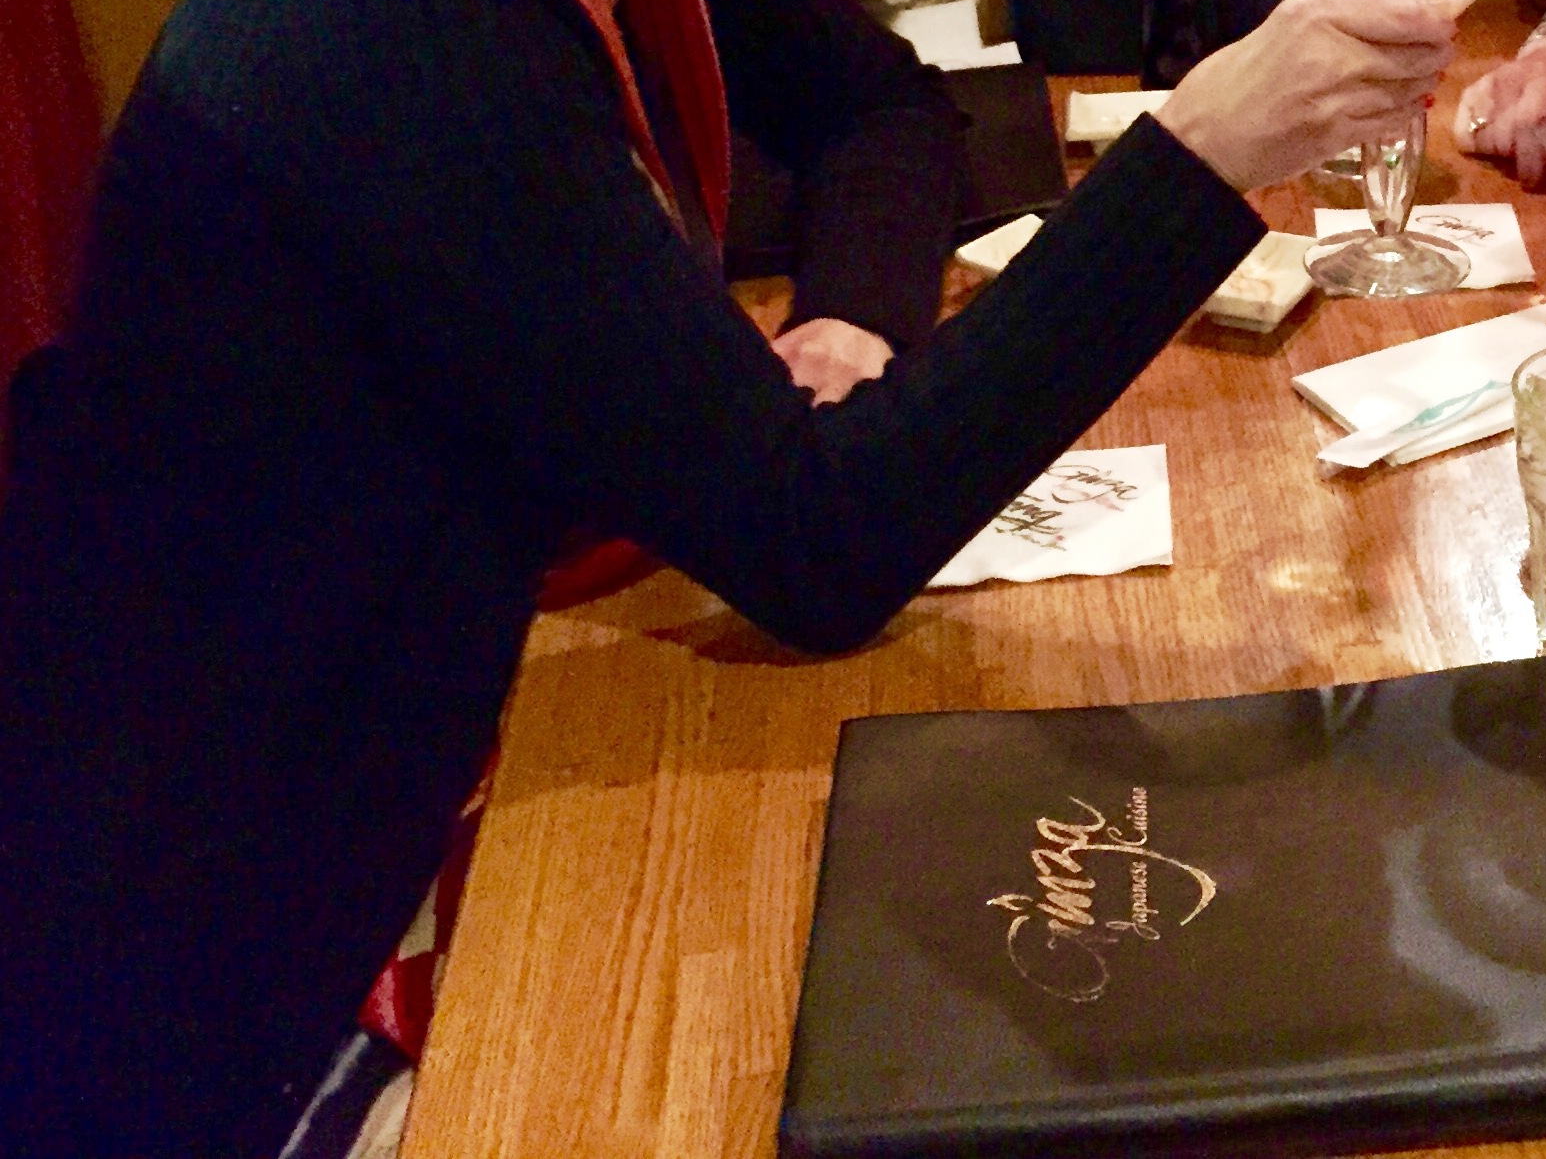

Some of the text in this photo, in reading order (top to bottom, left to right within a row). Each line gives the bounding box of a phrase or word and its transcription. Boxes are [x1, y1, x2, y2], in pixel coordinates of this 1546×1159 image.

[986, 796, 1217, 1003] Ginza
[1105, 787, 1160, 941] Japanese Cuisine
